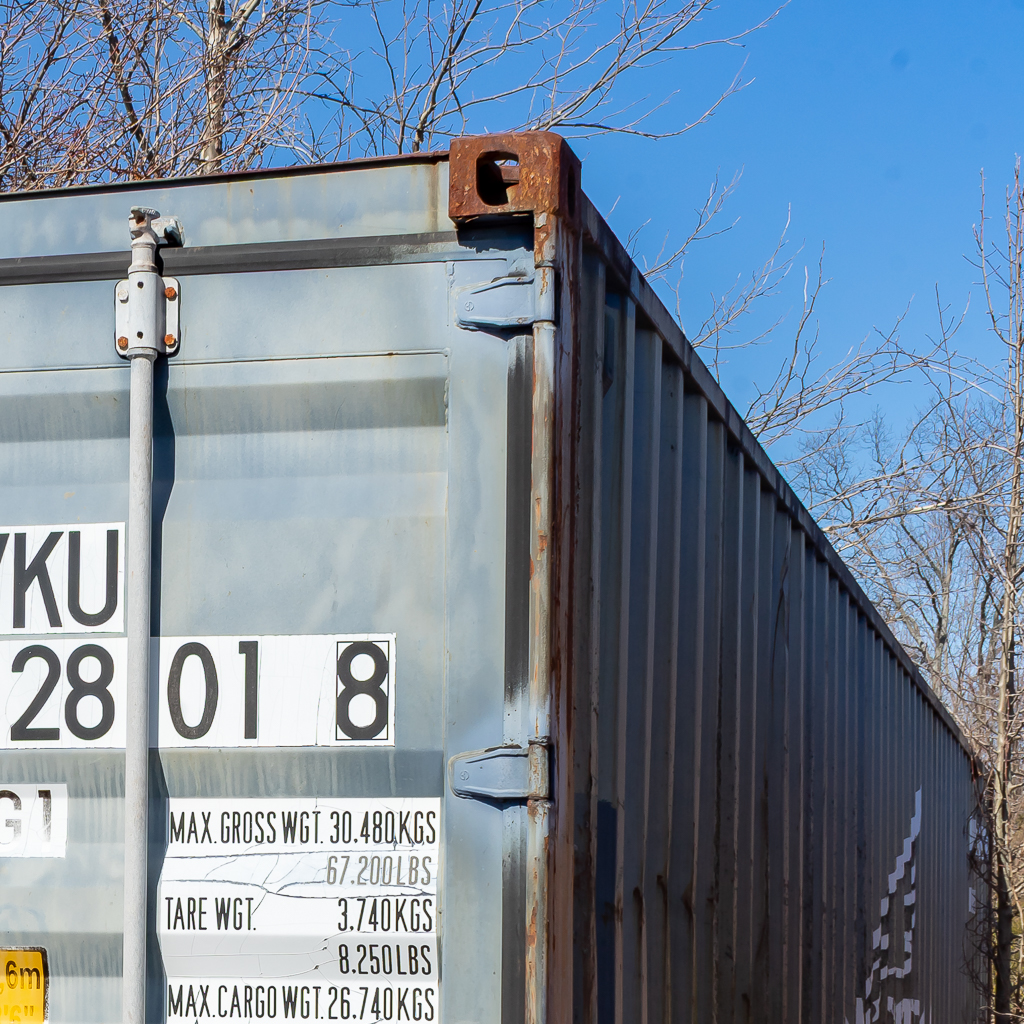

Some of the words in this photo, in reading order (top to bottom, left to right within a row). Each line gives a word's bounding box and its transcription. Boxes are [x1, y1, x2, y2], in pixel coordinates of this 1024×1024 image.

[167, 640, 260, 741] 01
[335, 640, 390, 741] 8
[170, 811, 217, 844] MAX.
[220, 811, 277, 844] GROSS
[281, 811, 324, 844] WGT.
[399, 811, 436, 844] KGS
[396, 856, 432, 886] LBS
[165, 897, 208, 931] TARE
[214, 897, 257, 931] WGT.
[395, 898, 433, 932] KGS
[397, 944, 432, 976] LBS
[167, 984, 216, 1018] MAX.
[218, 985, 277, 1019] CARGO
[281, 985, 324, 1020] WGT.
[397, 987, 435, 1022] KGS
